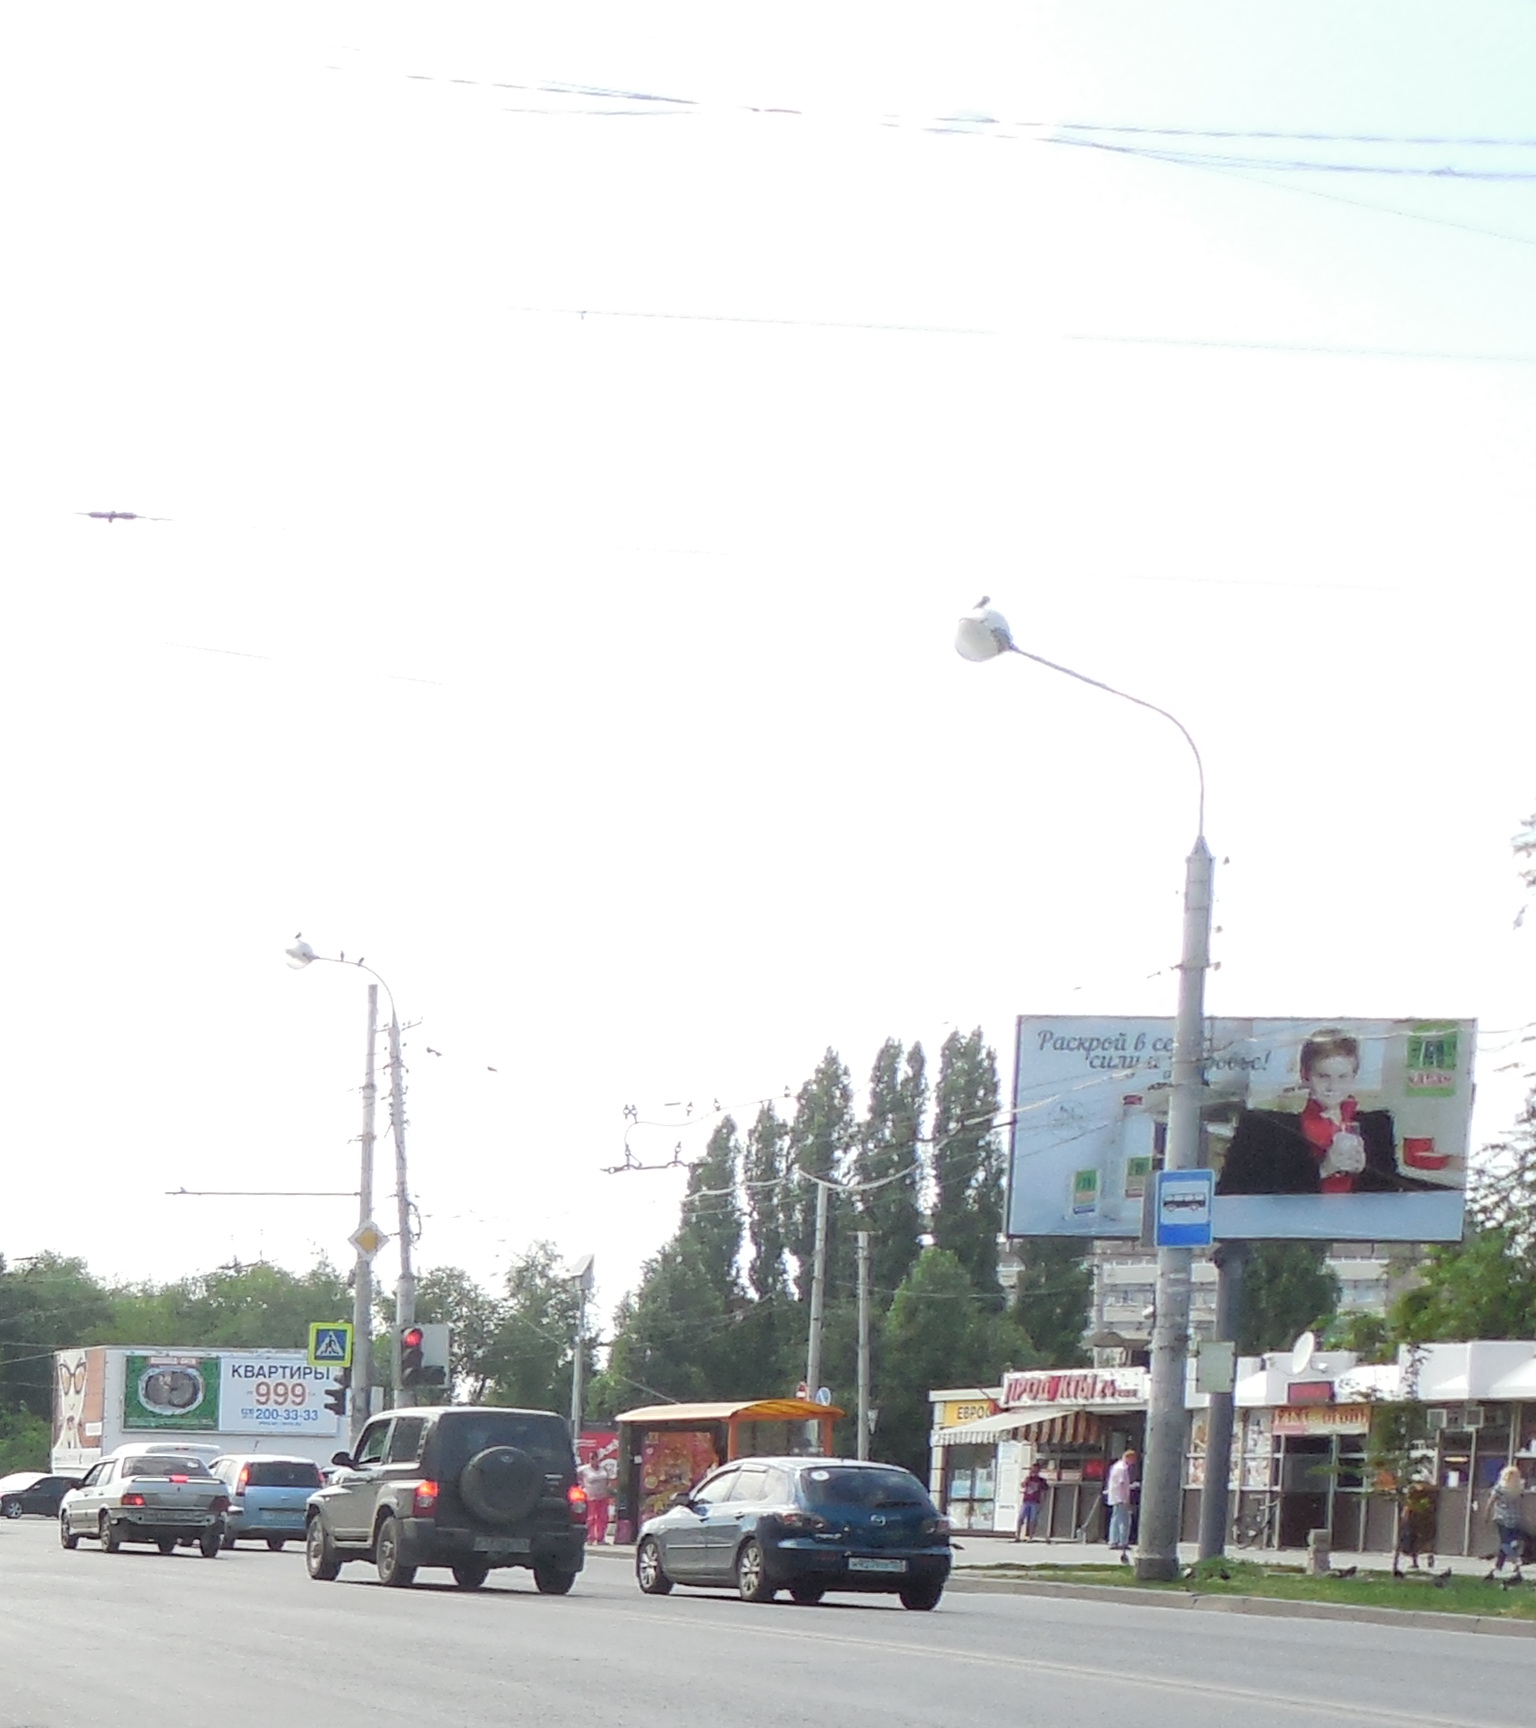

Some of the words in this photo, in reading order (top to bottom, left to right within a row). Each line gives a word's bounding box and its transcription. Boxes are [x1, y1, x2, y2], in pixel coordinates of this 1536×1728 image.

[1037, 1030, 1127, 1060] Раскрой
[1134, 1031, 1146, 1051] в
[231, 1365, 330, 1380] КВАРТИРЫ
[255, 1381, 307, 1406] 999
[255, 1408, 319, 1421] 200-33-33
